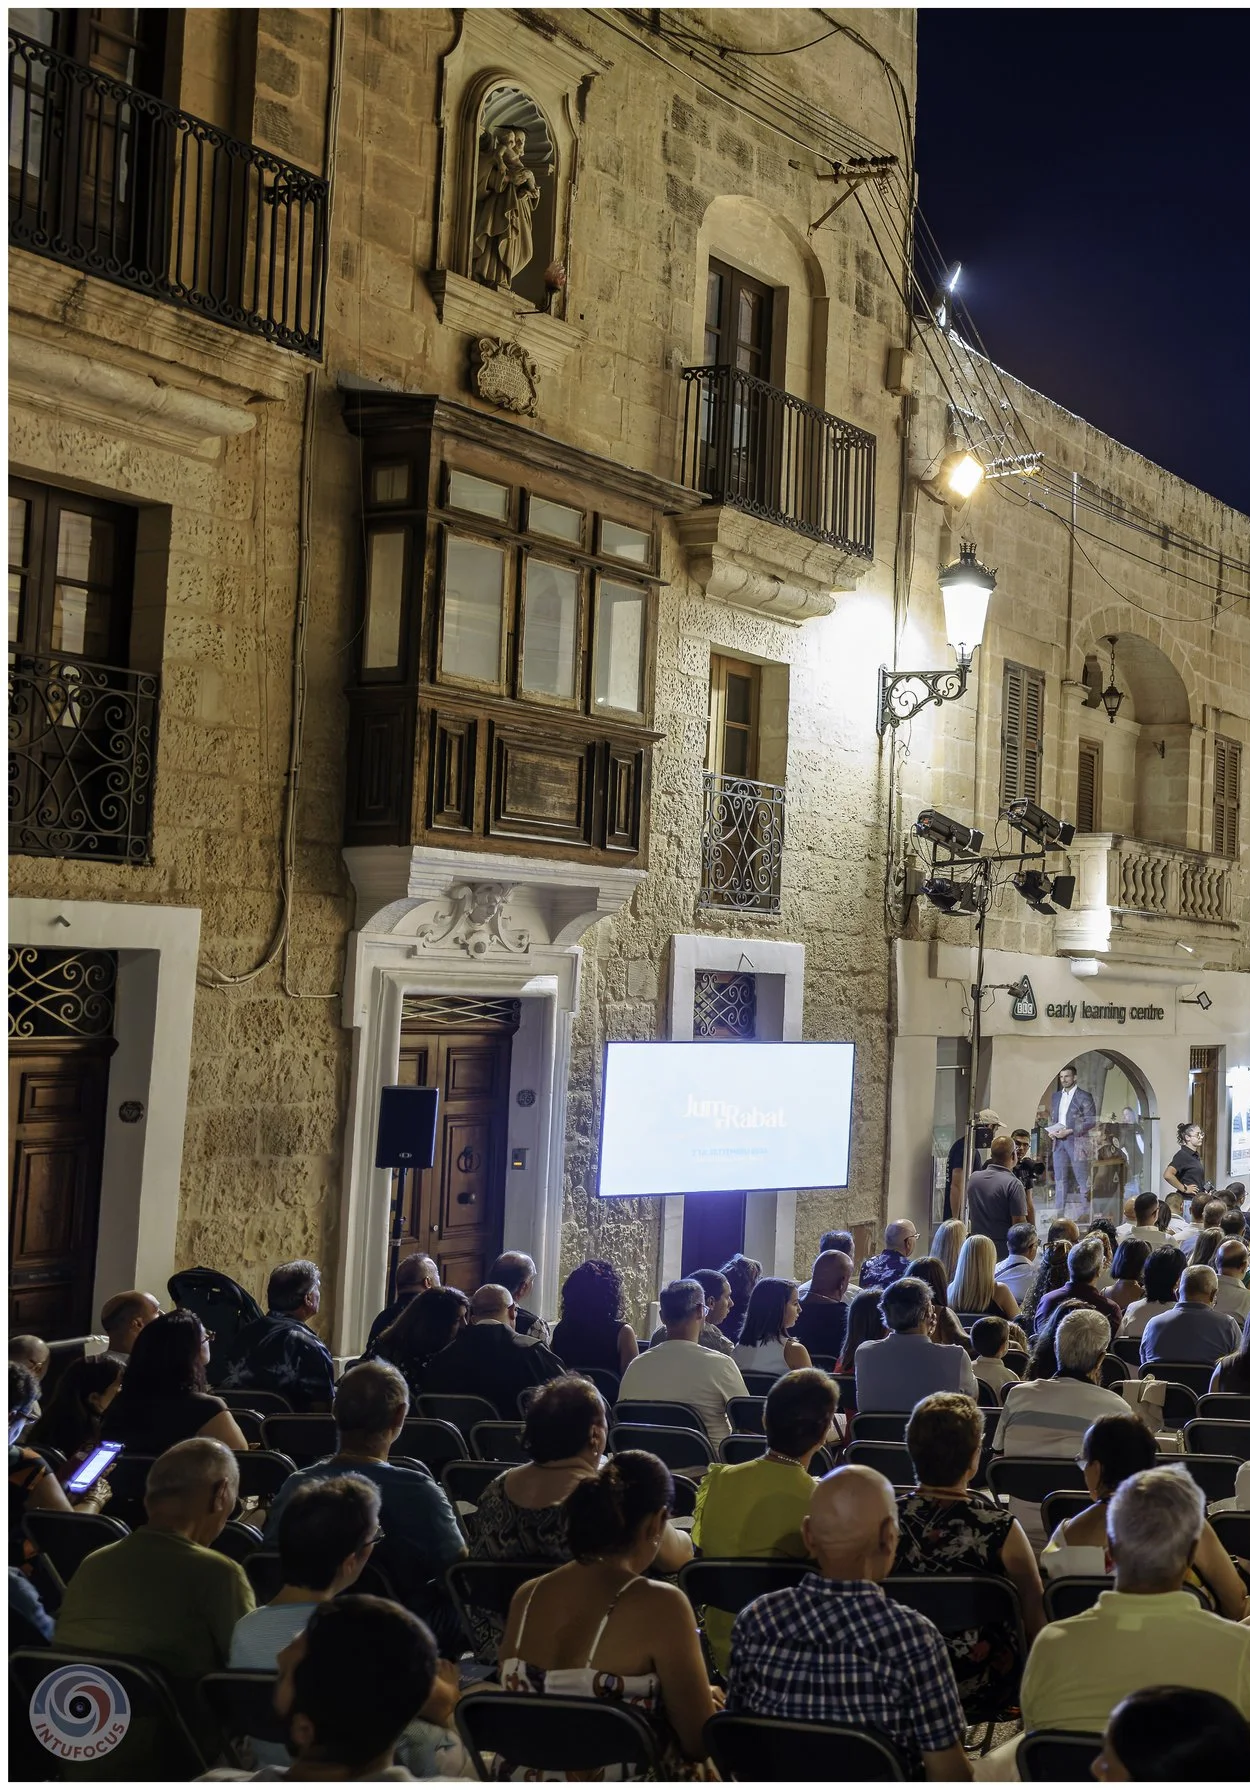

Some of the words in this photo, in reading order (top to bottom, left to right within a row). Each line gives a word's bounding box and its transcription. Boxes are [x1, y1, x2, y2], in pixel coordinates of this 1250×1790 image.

[1047, 1000, 1077, 1023] early
[1082, 1001, 1126, 1024] learning
[1130, 1004, 1165, 1020] centre
